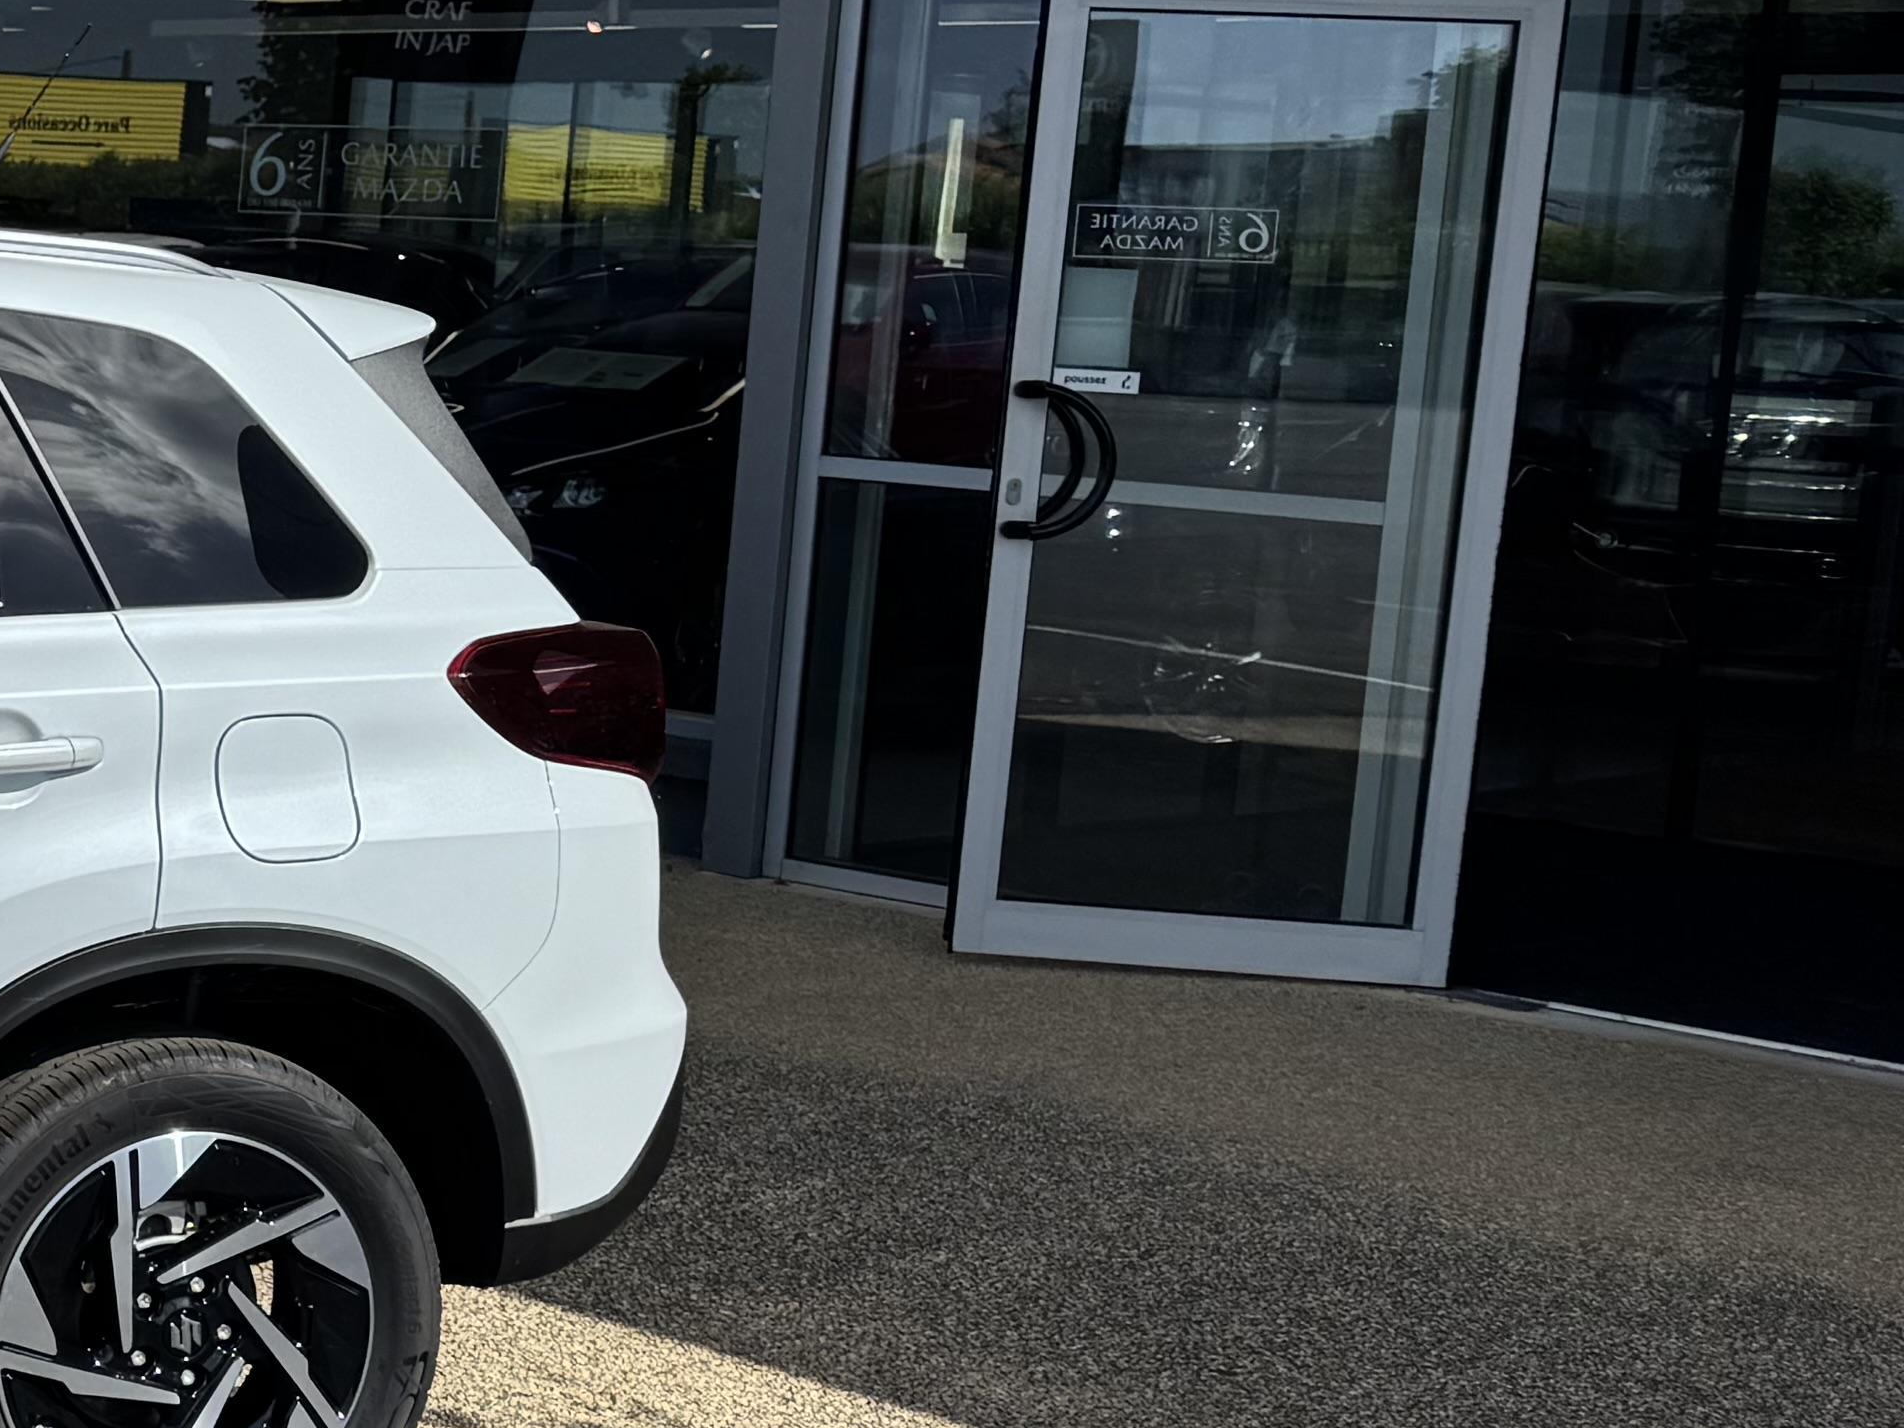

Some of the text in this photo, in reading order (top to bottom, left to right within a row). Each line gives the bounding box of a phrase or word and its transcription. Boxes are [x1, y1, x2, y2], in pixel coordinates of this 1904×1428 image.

[425, 31, 471, 56] JAP
[250, 132, 316, 197] 6 ANS
[341, 142, 483, 169] GARANTIE
[352, 177, 463, 204] MAZDA
